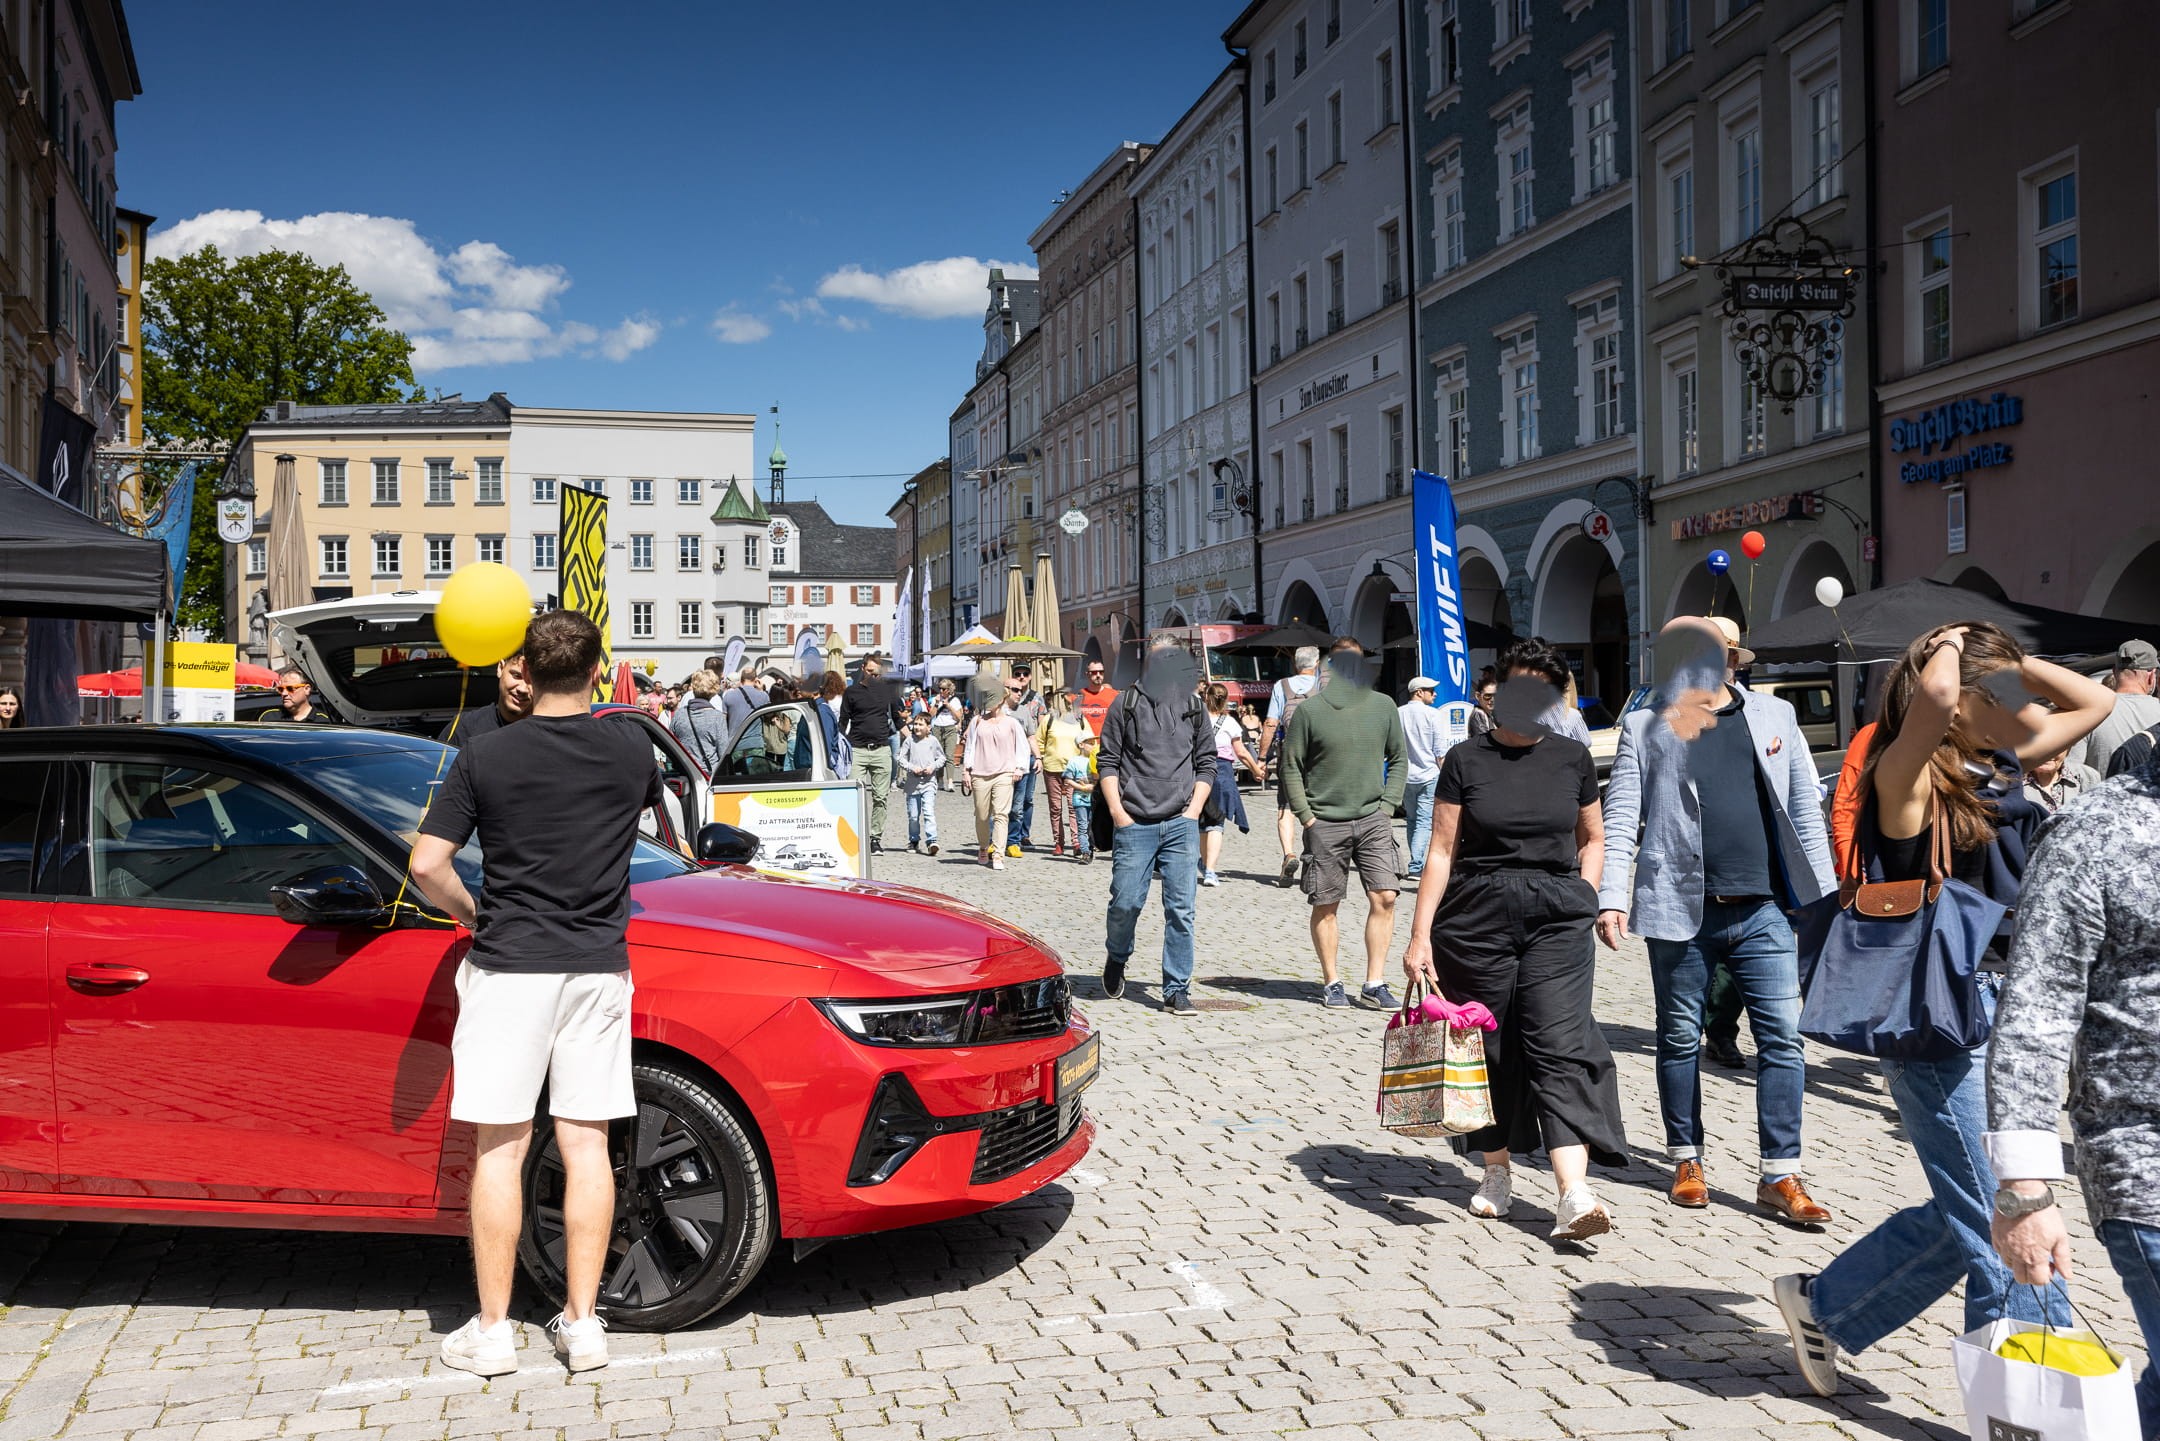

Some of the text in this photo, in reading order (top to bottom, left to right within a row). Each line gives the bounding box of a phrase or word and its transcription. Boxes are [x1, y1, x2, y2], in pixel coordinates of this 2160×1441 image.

[1800, 283, 1838, 300] Bräu
[1299, 373, 1349, 411] Zum Augustiner
[1954, 391, 2023, 437] Bräu
[1899, 442, 2010, 484] Georg am Platz
[1430, 524, 1468, 695] SWIFT
[177, 662, 230, 673] Vodermayer
[769, 817, 815, 825] ATTRAKTIVEN
